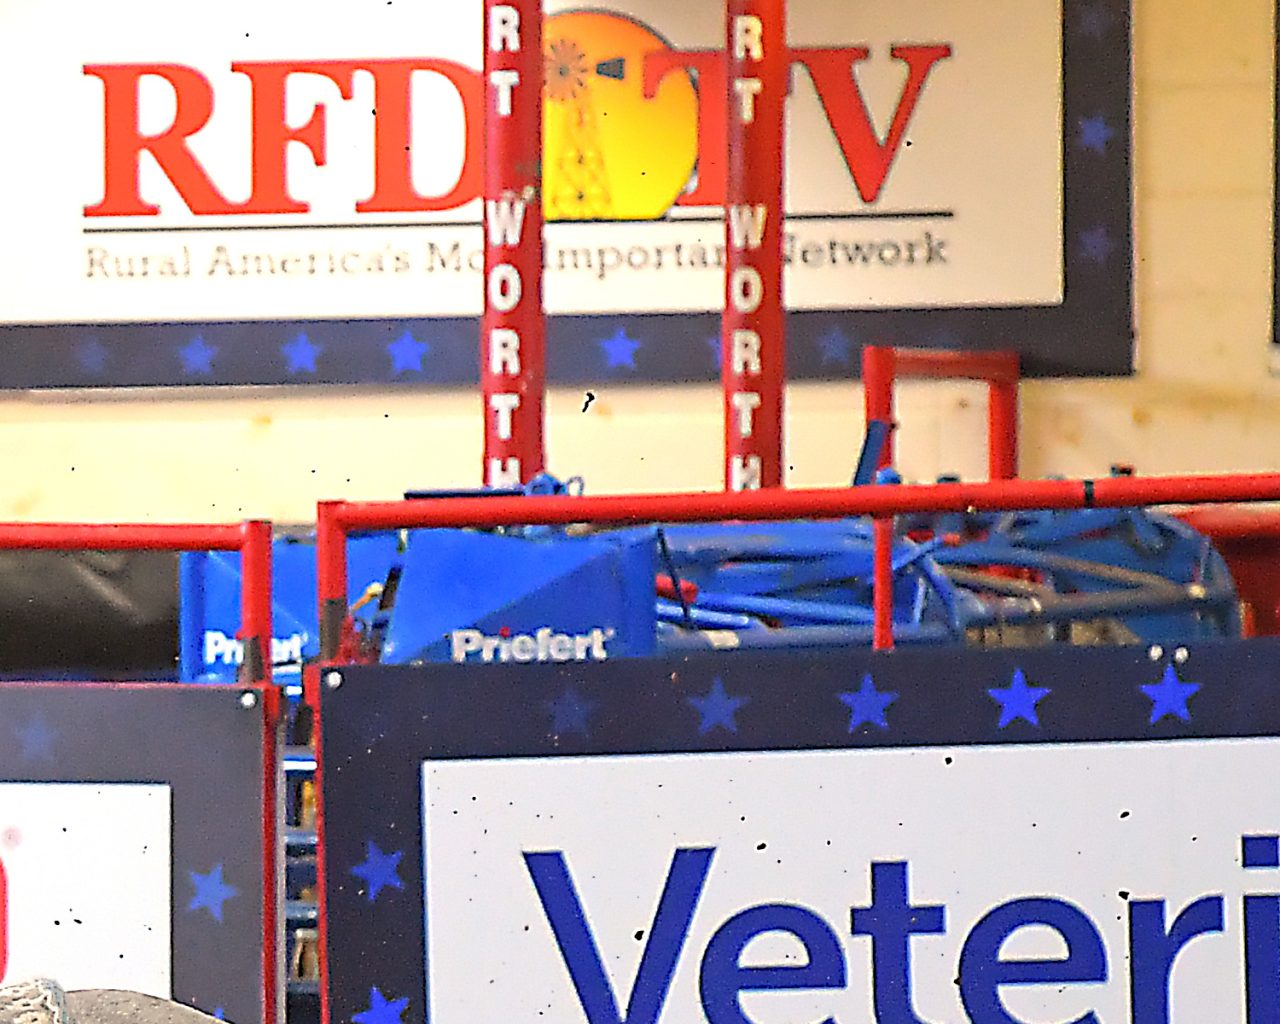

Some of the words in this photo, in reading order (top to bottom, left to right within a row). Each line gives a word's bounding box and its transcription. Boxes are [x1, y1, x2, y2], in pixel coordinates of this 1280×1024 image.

[83, 57, 484, 217] RFD
[87, 246, 190, 277] Rural
[208, 244, 410, 275] America's
[426, 242, 483, 272] Mo
[486, 199, 525, 488] WORTH
[728, 203, 767, 490] WORTH
[204, 629, 303, 664] Priert
[452, 627, 607, 663] Priefert
